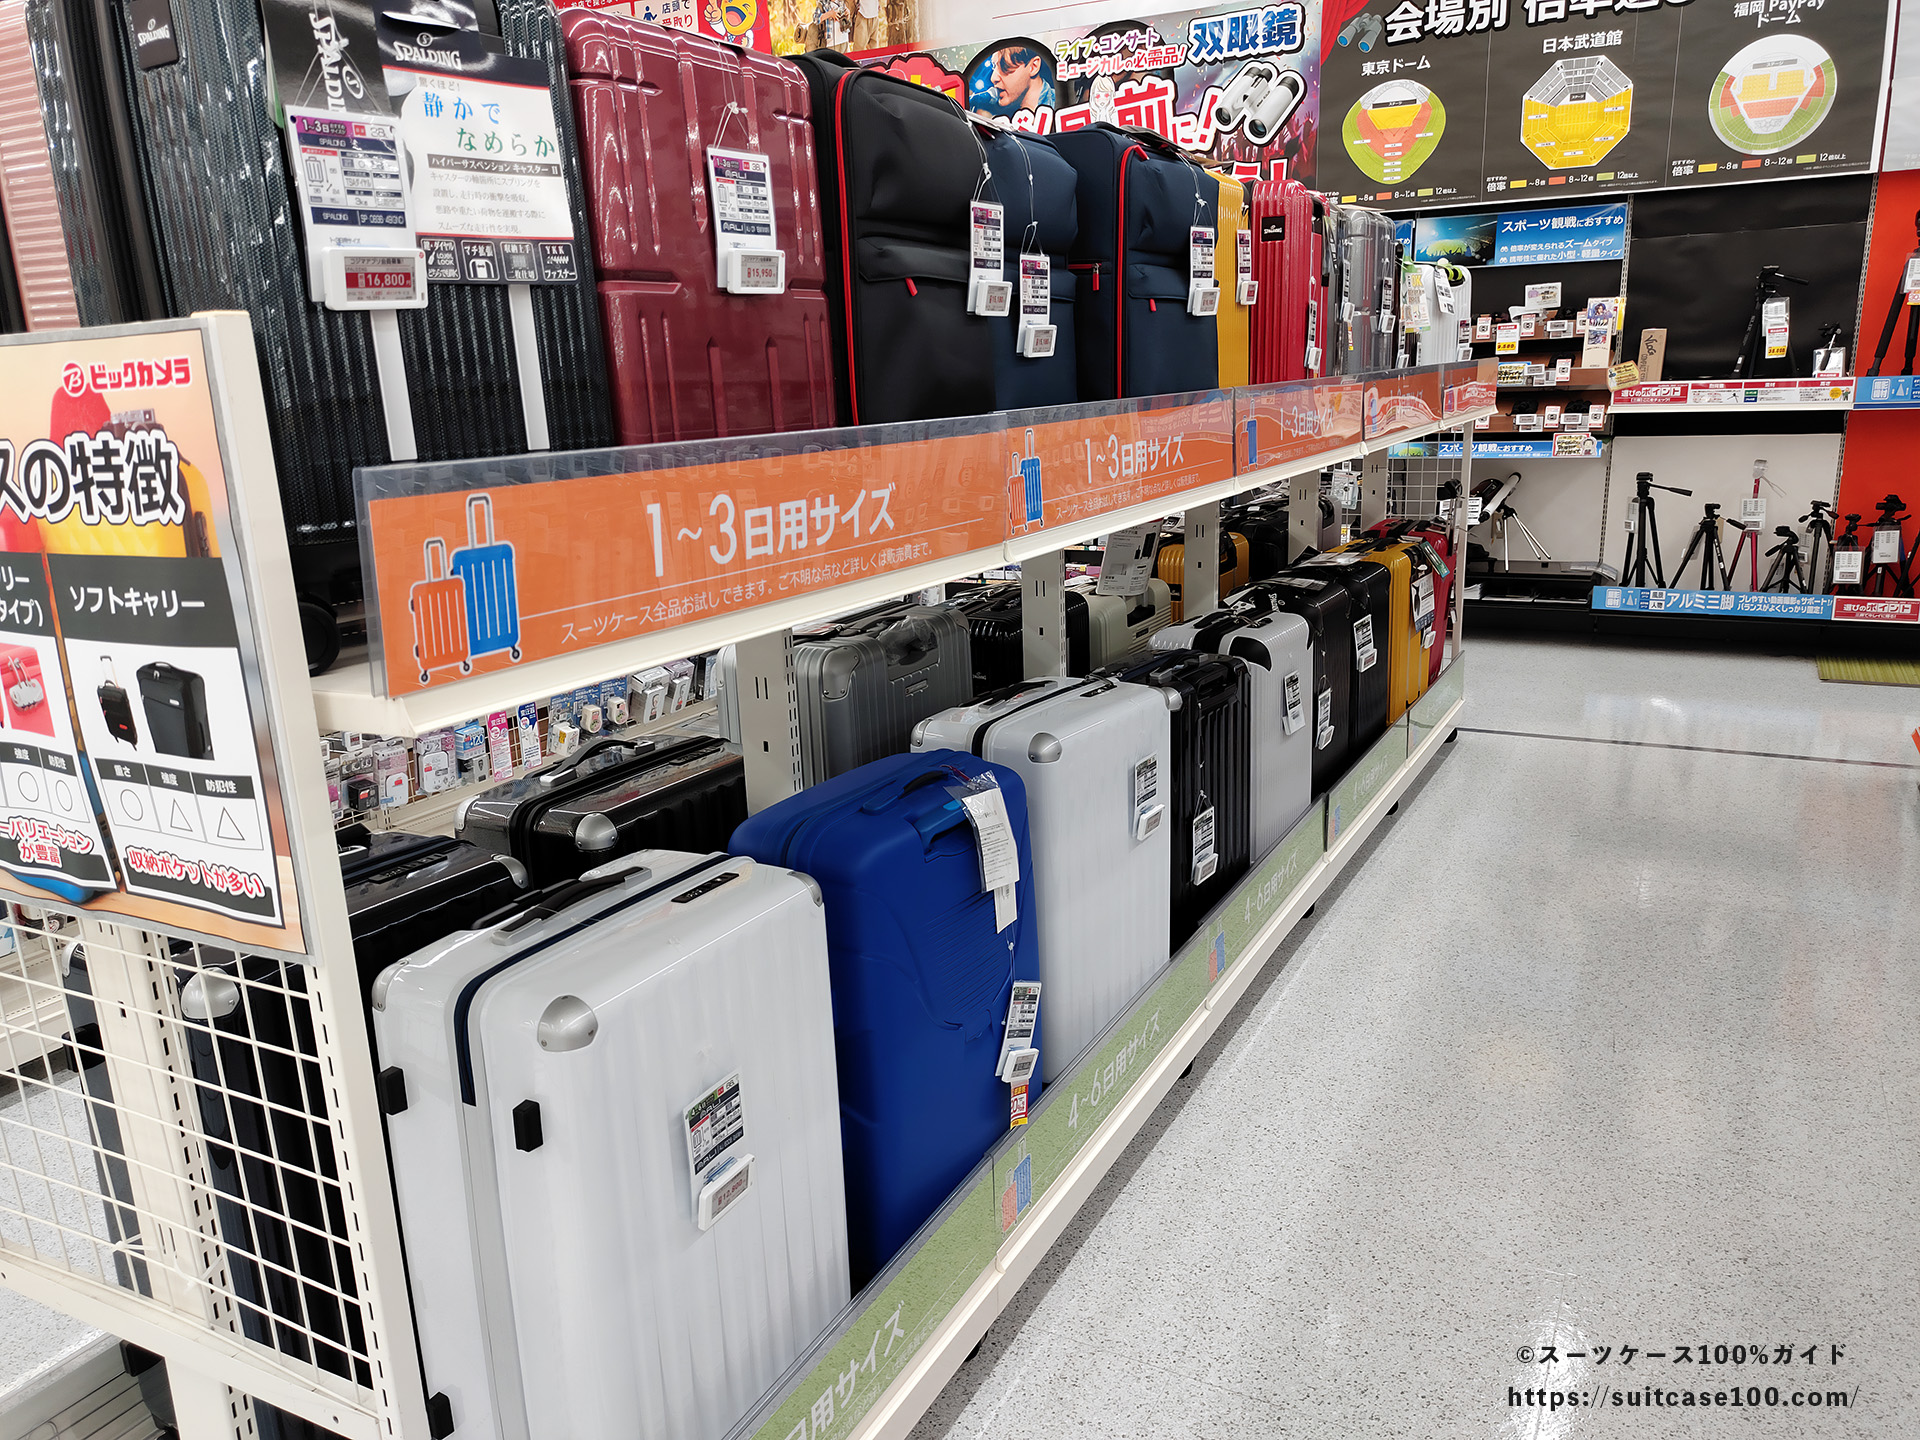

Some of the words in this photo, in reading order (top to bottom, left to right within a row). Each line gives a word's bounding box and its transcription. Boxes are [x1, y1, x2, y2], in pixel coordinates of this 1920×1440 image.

[661, 0, 691, 14] 店頭で
[1733, 1, 1764, 18] 福岡
[1386, 0, 1507, 43] 会場別
[1757, 12, 1801, 28] ドーム
[138, 24, 171, 47] SPALDING
[1056, 27, 1160, 62] ライブ・コンサート
[1192, 8, 1298, 58] 双眼鏡
[1542, 30, 1624, 54] 日本武道館
[393, 41, 462, 71] SPALDING
[1056, 43, 1187, 80] ミュージカルの必需品!
[1361, 55, 1432, 77] 東京ドーム
[418, 76, 461, 92] 驚くほど!
[423, 91, 501, 125] 静かで
[455, 126, 556, 158] なめらか
[431, 157, 511, 172] ハイパーサスペンション
[1501, 214, 1625, 234] スポーツ観戦におすすめ
[544, 244, 566, 255] YKK
[1510, 237, 1615, 252] 倍率が変えられるズームタイプ
[544, 269, 576, 280] ファスナー
[90, 357, 191, 390] ビックカメラ
[1085, 432, 1185, 484] 1～3日用サイズ
[646, 482, 897, 578] 1～3日用サイズ
[69, 585, 206, 618] ソフトキャリー
[560, 583, 775, 645] スーツケース全品お試しできます。
[778, 543, 933, 593] ご不明な点など詳しくは販売員まで。
[1666, 591, 1735, 611] アルミ三脚
[14, 747, 31, 762] 強度
[113, 765, 132, 778] 重さ
[160, 771, 180, 786] 強度
[204, 779, 238, 794] 防犯性
[19, 841, 62, 866] が豊富
[128, 848, 265, 896] 収納ポケットが多い
[1067, 1007, 1162, 1131] 4～6日用サイズ
